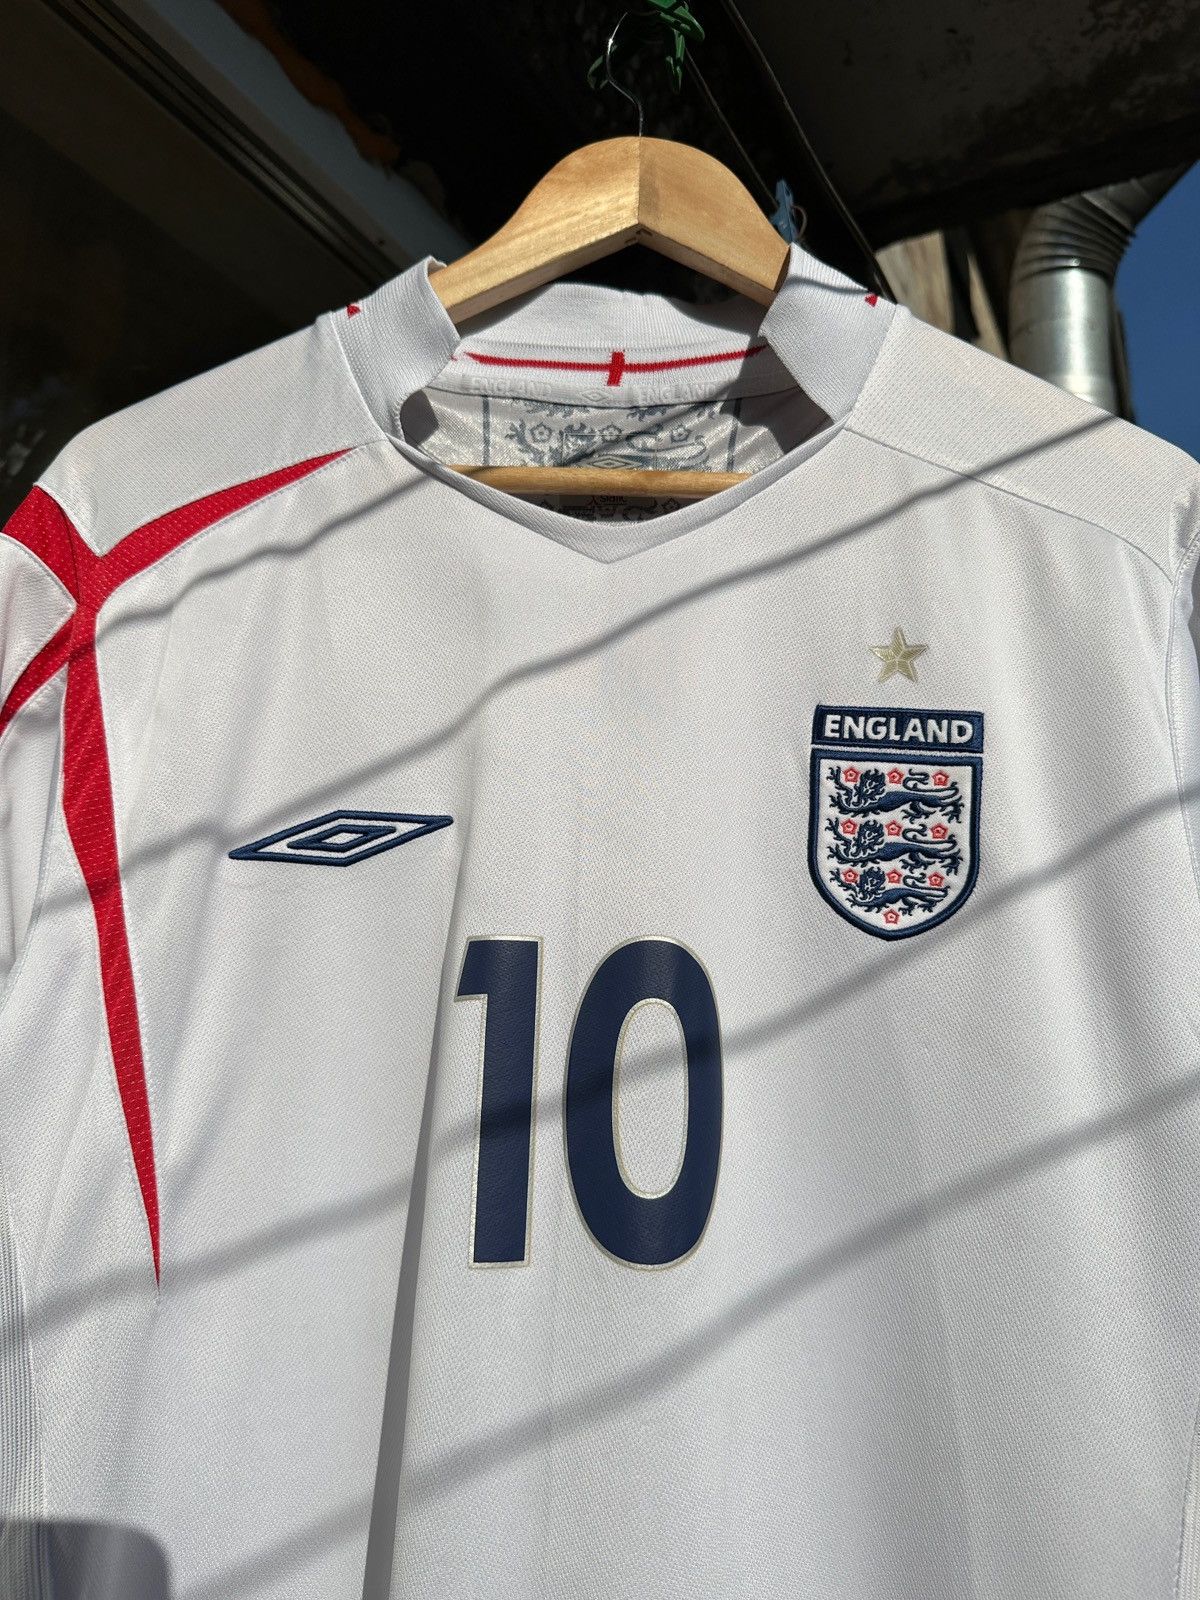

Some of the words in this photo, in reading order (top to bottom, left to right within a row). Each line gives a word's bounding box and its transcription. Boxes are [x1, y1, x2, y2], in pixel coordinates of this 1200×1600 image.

[471, 377, 553, 398] ENGLAND
[635, 381, 722, 404] ENGLAND
[823, 714, 974, 744] ENGLAND
[453, 934, 724, 1271] 10
